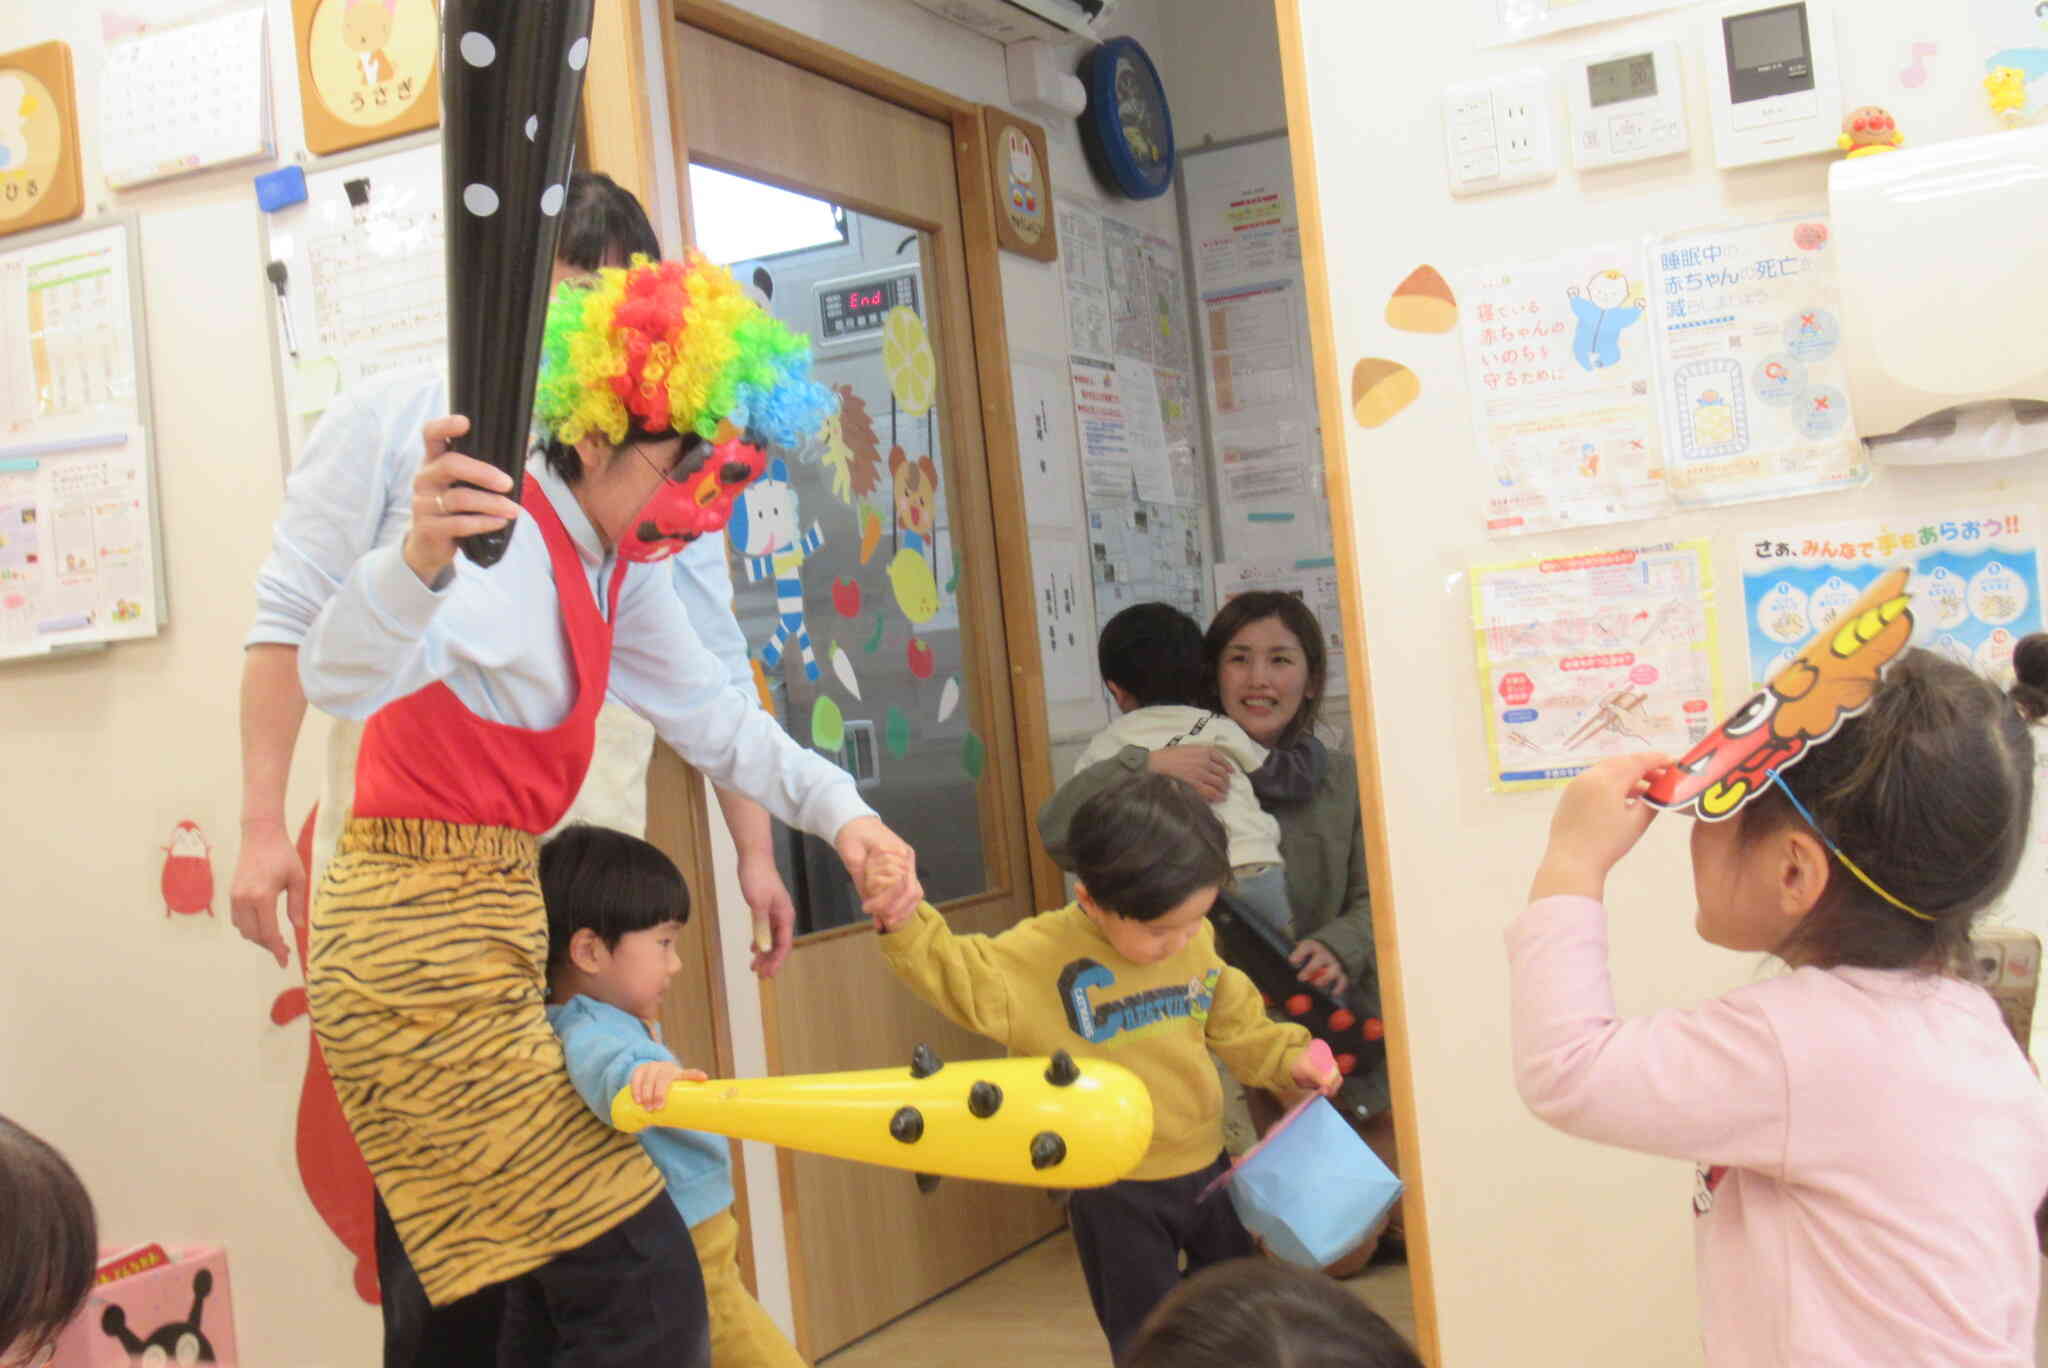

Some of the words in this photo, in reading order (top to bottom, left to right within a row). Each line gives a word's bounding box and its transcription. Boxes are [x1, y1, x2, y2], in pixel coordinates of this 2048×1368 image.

[350, 76, 412, 113] うさぎ
[848, 289, 882, 310] End
[1480, 319, 1567, 346] 赤ちゃんの
[1482, 358, 1568, 391] 守るために
